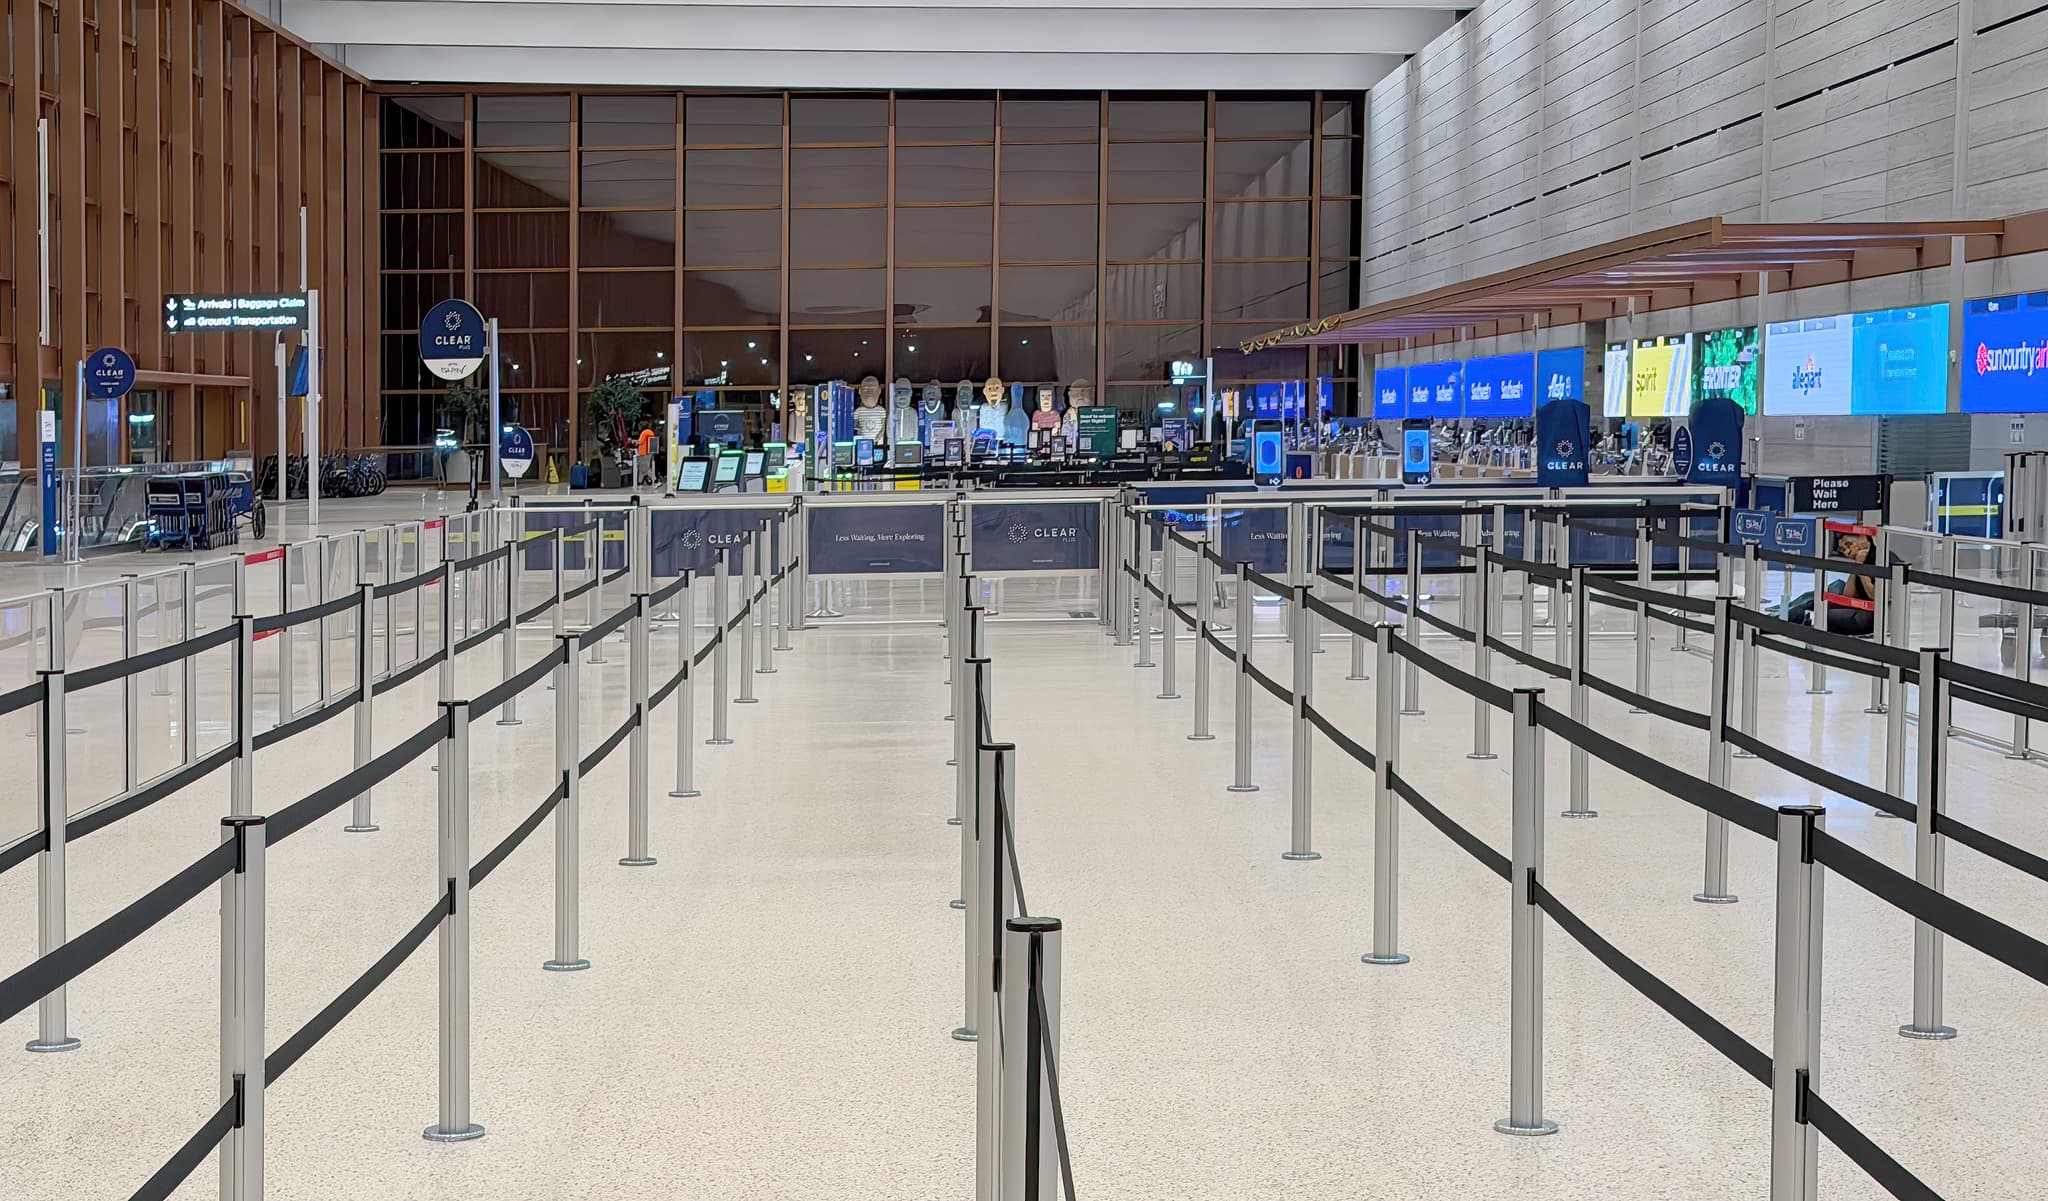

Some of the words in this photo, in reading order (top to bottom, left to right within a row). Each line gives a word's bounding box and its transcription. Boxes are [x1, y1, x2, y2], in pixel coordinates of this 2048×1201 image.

[198, 299, 232, 309] Arrivals
[238, 299, 279, 310] Baggage
[279, 298, 306, 309] Claim
[197, 316, 232, 326] Ground
[232, 315, 297, 327] Transportation
[435, 336, 471, 345] CLEAR
[95, 369, 123, 377] CLEAR
[1636, 367, 1657, 397] spirit
[1547, 461, 1583, 470] CLEAR
[1697, 463, 1735, 471] CLEAR
[1813, 478, 1849, 488] Please
[1812, 489, 1837, 498] Wait
[1812, 499, 1838, 509] Here
[894, 532, 925, 542] Exploring
[1034, 527, 1076, 537] CLEAR
[708, 534, 740, 544] CLEA
